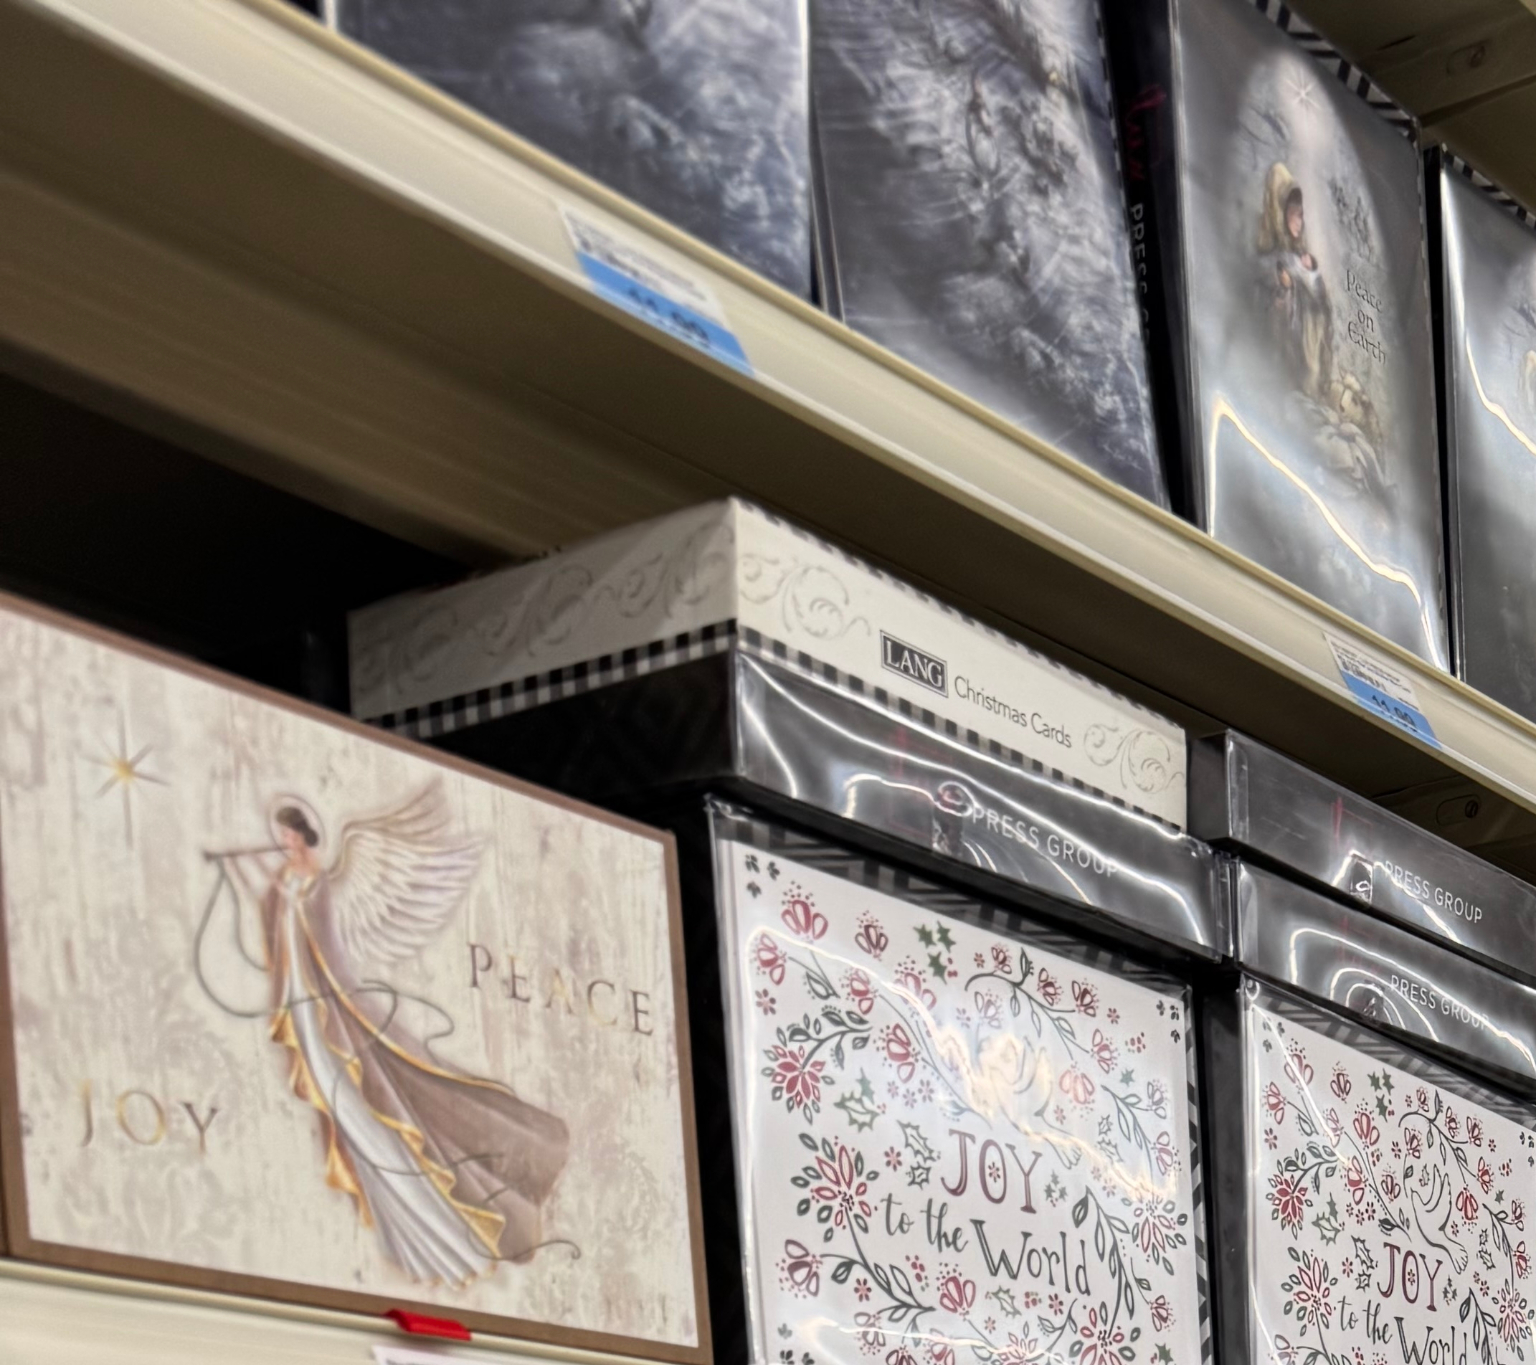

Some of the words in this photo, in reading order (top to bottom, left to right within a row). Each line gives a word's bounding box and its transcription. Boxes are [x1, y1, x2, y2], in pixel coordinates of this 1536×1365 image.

[1347, 269, 1382, 313] Peace
[1358, 310, 1374, 333] on
[1348, 321, 1386, 365] Earth
[884, 639, 943, 692] LANG
[953, 674, 1028, 729] Christmas
[1030, 711, 1074, 751] Cards
[973, 802, 1039, 850] PRESS
[1047, 831, 1120, 880] GROUP
[1384, 858, 1432, 901] PRESS
[1434, 886, 1483, 925] GROUP
[466, 941, 656, 1039] PEACE
[1389, 973, 1438, 1012] PRESS
[80, 1079, 222, 1152] JOY
[940, 1127, 1043, 1216] JOY
[880, 1192, 915, 1238] to
[920, 1197, 970, 1254] the
[969, 1217, 1093, 1298] World
[1376, 1241, 1445, 1313] JOY
[1338, 1293, 1360, 1332] to
[1361, 1298, 1394, 1346] the
